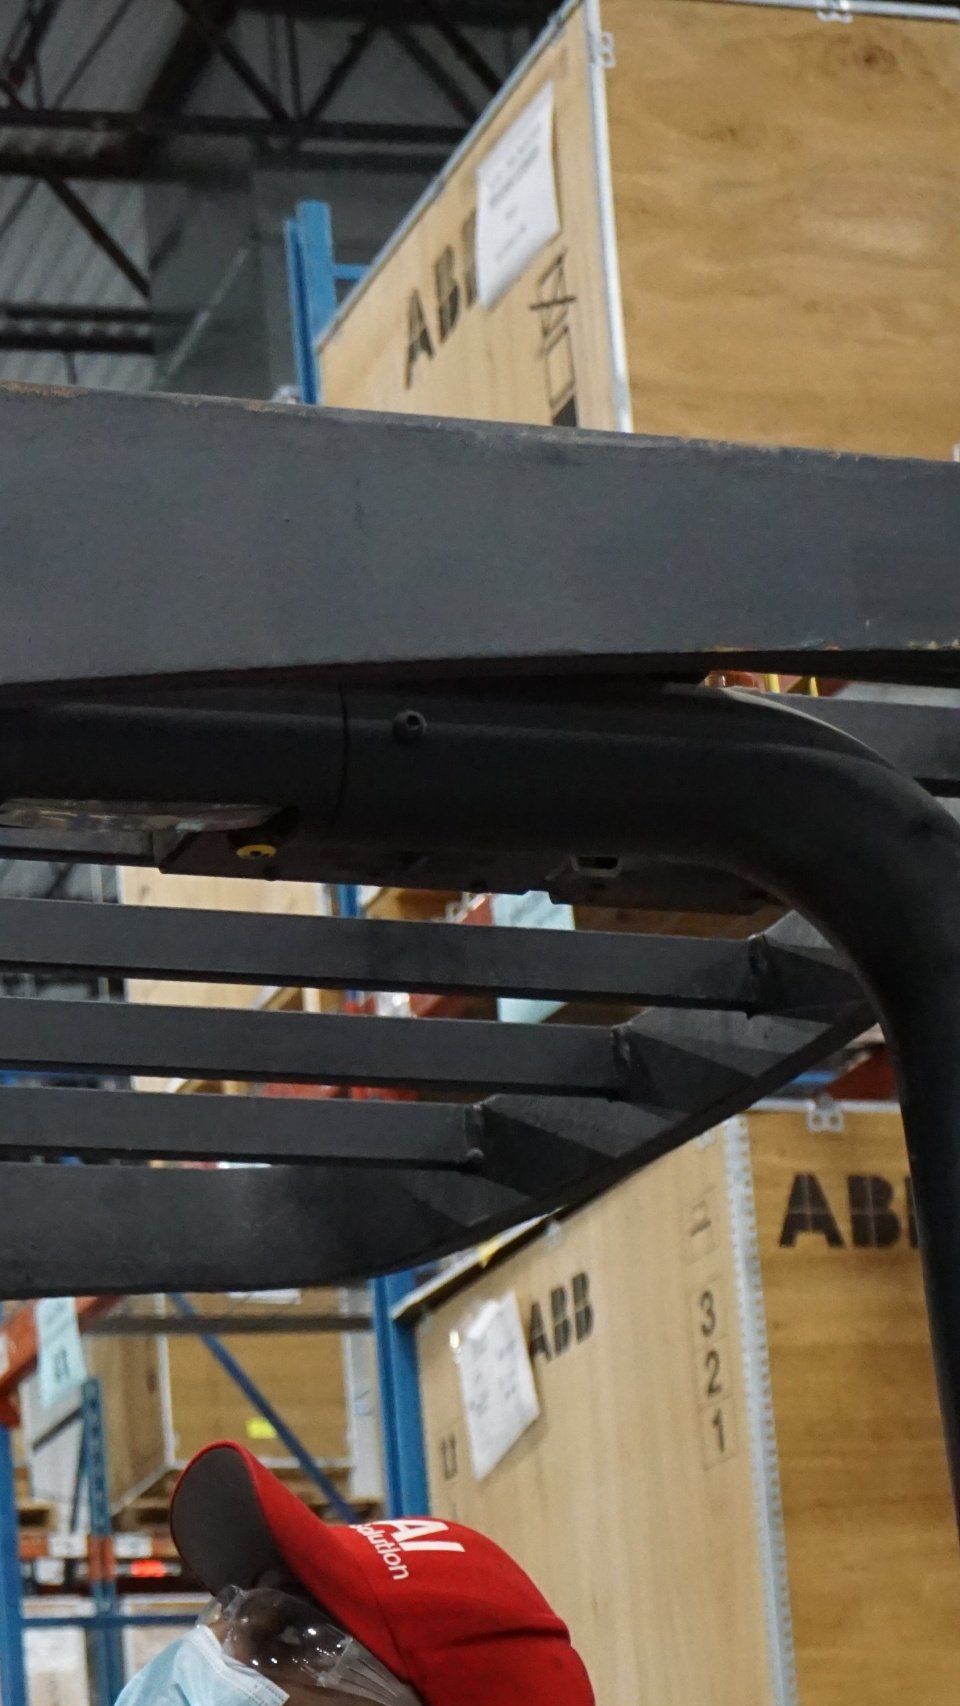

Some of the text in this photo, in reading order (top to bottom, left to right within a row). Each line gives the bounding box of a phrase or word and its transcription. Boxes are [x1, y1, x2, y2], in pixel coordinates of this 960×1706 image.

[779, 1172, 920, 1249] AB
[528, 1271, 595, 1363] ABB
[699, 1290, 717, 1338] 3
[704, 1350, 723, 1399] 2
[712, 1408, 726, 1453] 1
